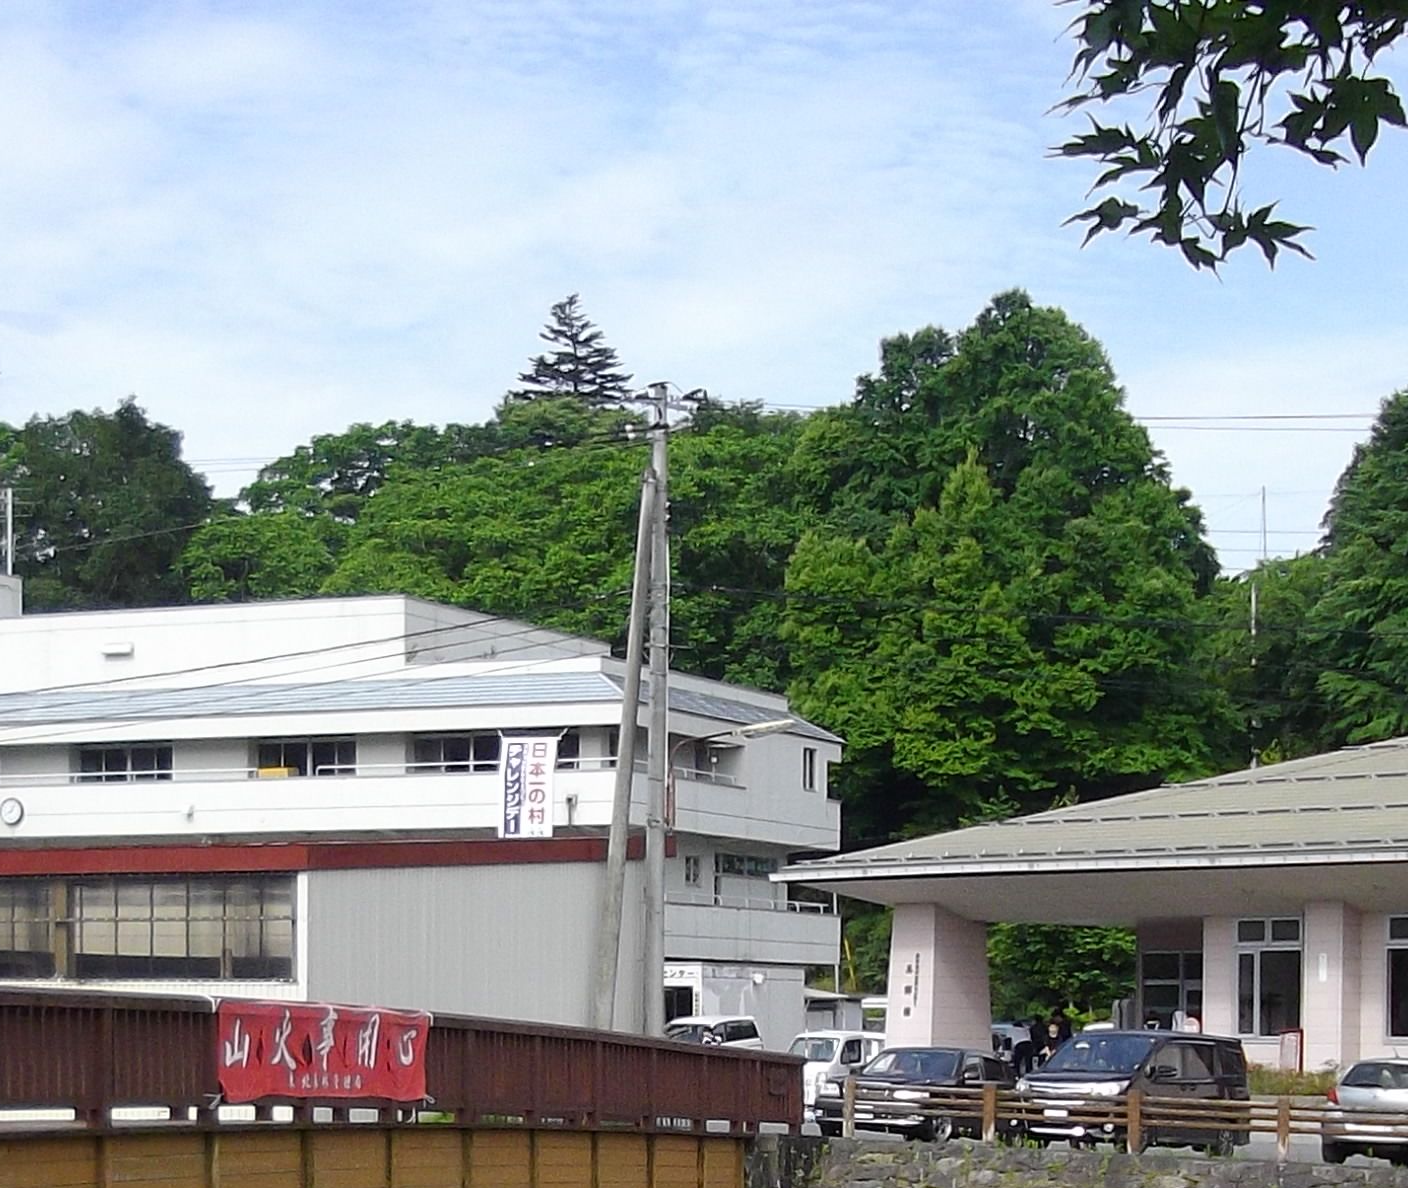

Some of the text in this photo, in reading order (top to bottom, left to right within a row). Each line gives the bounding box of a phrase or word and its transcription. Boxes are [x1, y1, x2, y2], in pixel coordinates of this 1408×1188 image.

[528, 742, 547, 824] 日本一の村
